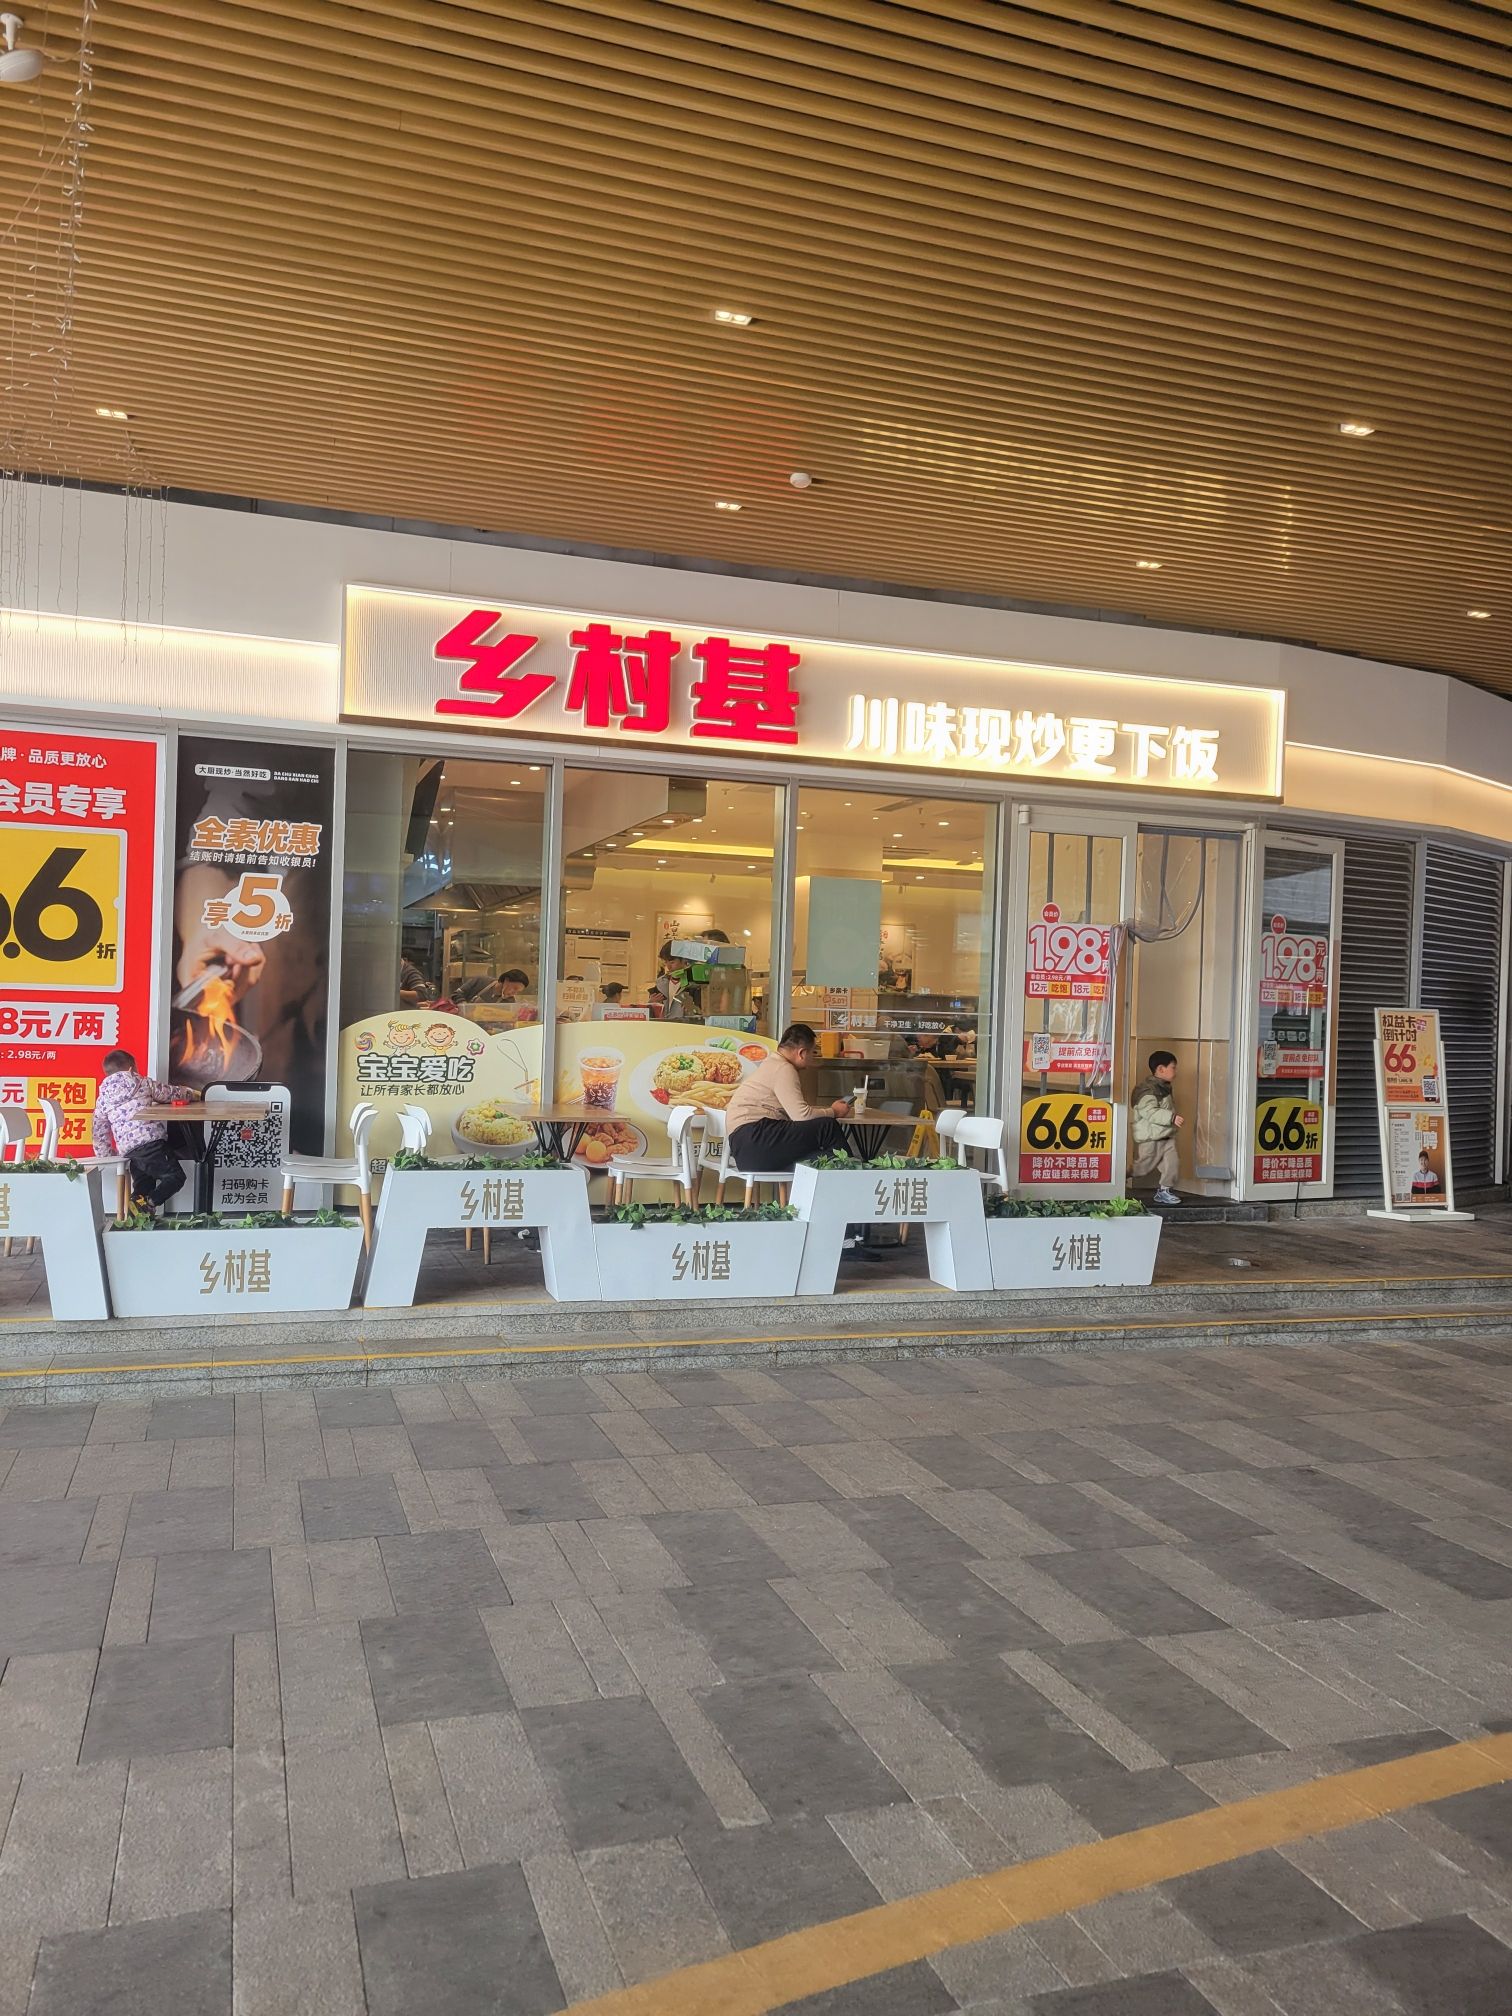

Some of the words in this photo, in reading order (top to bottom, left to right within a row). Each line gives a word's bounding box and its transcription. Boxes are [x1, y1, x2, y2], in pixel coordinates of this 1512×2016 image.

[434, 610, 800, 744] 乡村基
[845, 694, 1220, 782] 川味现炒更下饭
[0, 779, 127, 820] 会员专享
[192, 816, 322, 855] 全素优惠
[190, 851, 316, 868] 结账时请提前告知收银员!
[1029, 925, 1102, 974] 1.98
[1261, 936, 1316, 982] 1.98
[1031, 982, 1047, 992] 12元
[1073, 984, 1090, 994] 18元
[1382, 1014, 1416, 1028] 权益卡
[1383, 1028, 1417, 1042] 倒计时
[357, 1053, 475, 1082] 宝宝爱吃
[2, 1082, 24, 1101] 元
[37, 1082, 87, 1104] 吃饱
[360, 1084, 465, 1096] 让所有家长都放心
[1032, 1157, 1099, 1168] 降价不降品质
[1262, 1158, 1312, 1168] 降价不降品质
[221, 1179, 269, 1190] 扫码购卡
[1032, 1169, 1099, 1180] 供应链集采保障
[221, 1192, 268, 1204] 成为会员
[460, 1178, 524, 1220] 乡村基
[874, 1177, 928, 1215] 乡村基
[672, 1240, 731, 1281] 乡村基
[1052, 1234, 1101, 1270] 乡村基
[200, 1249, 271, 1294] 乡村基
